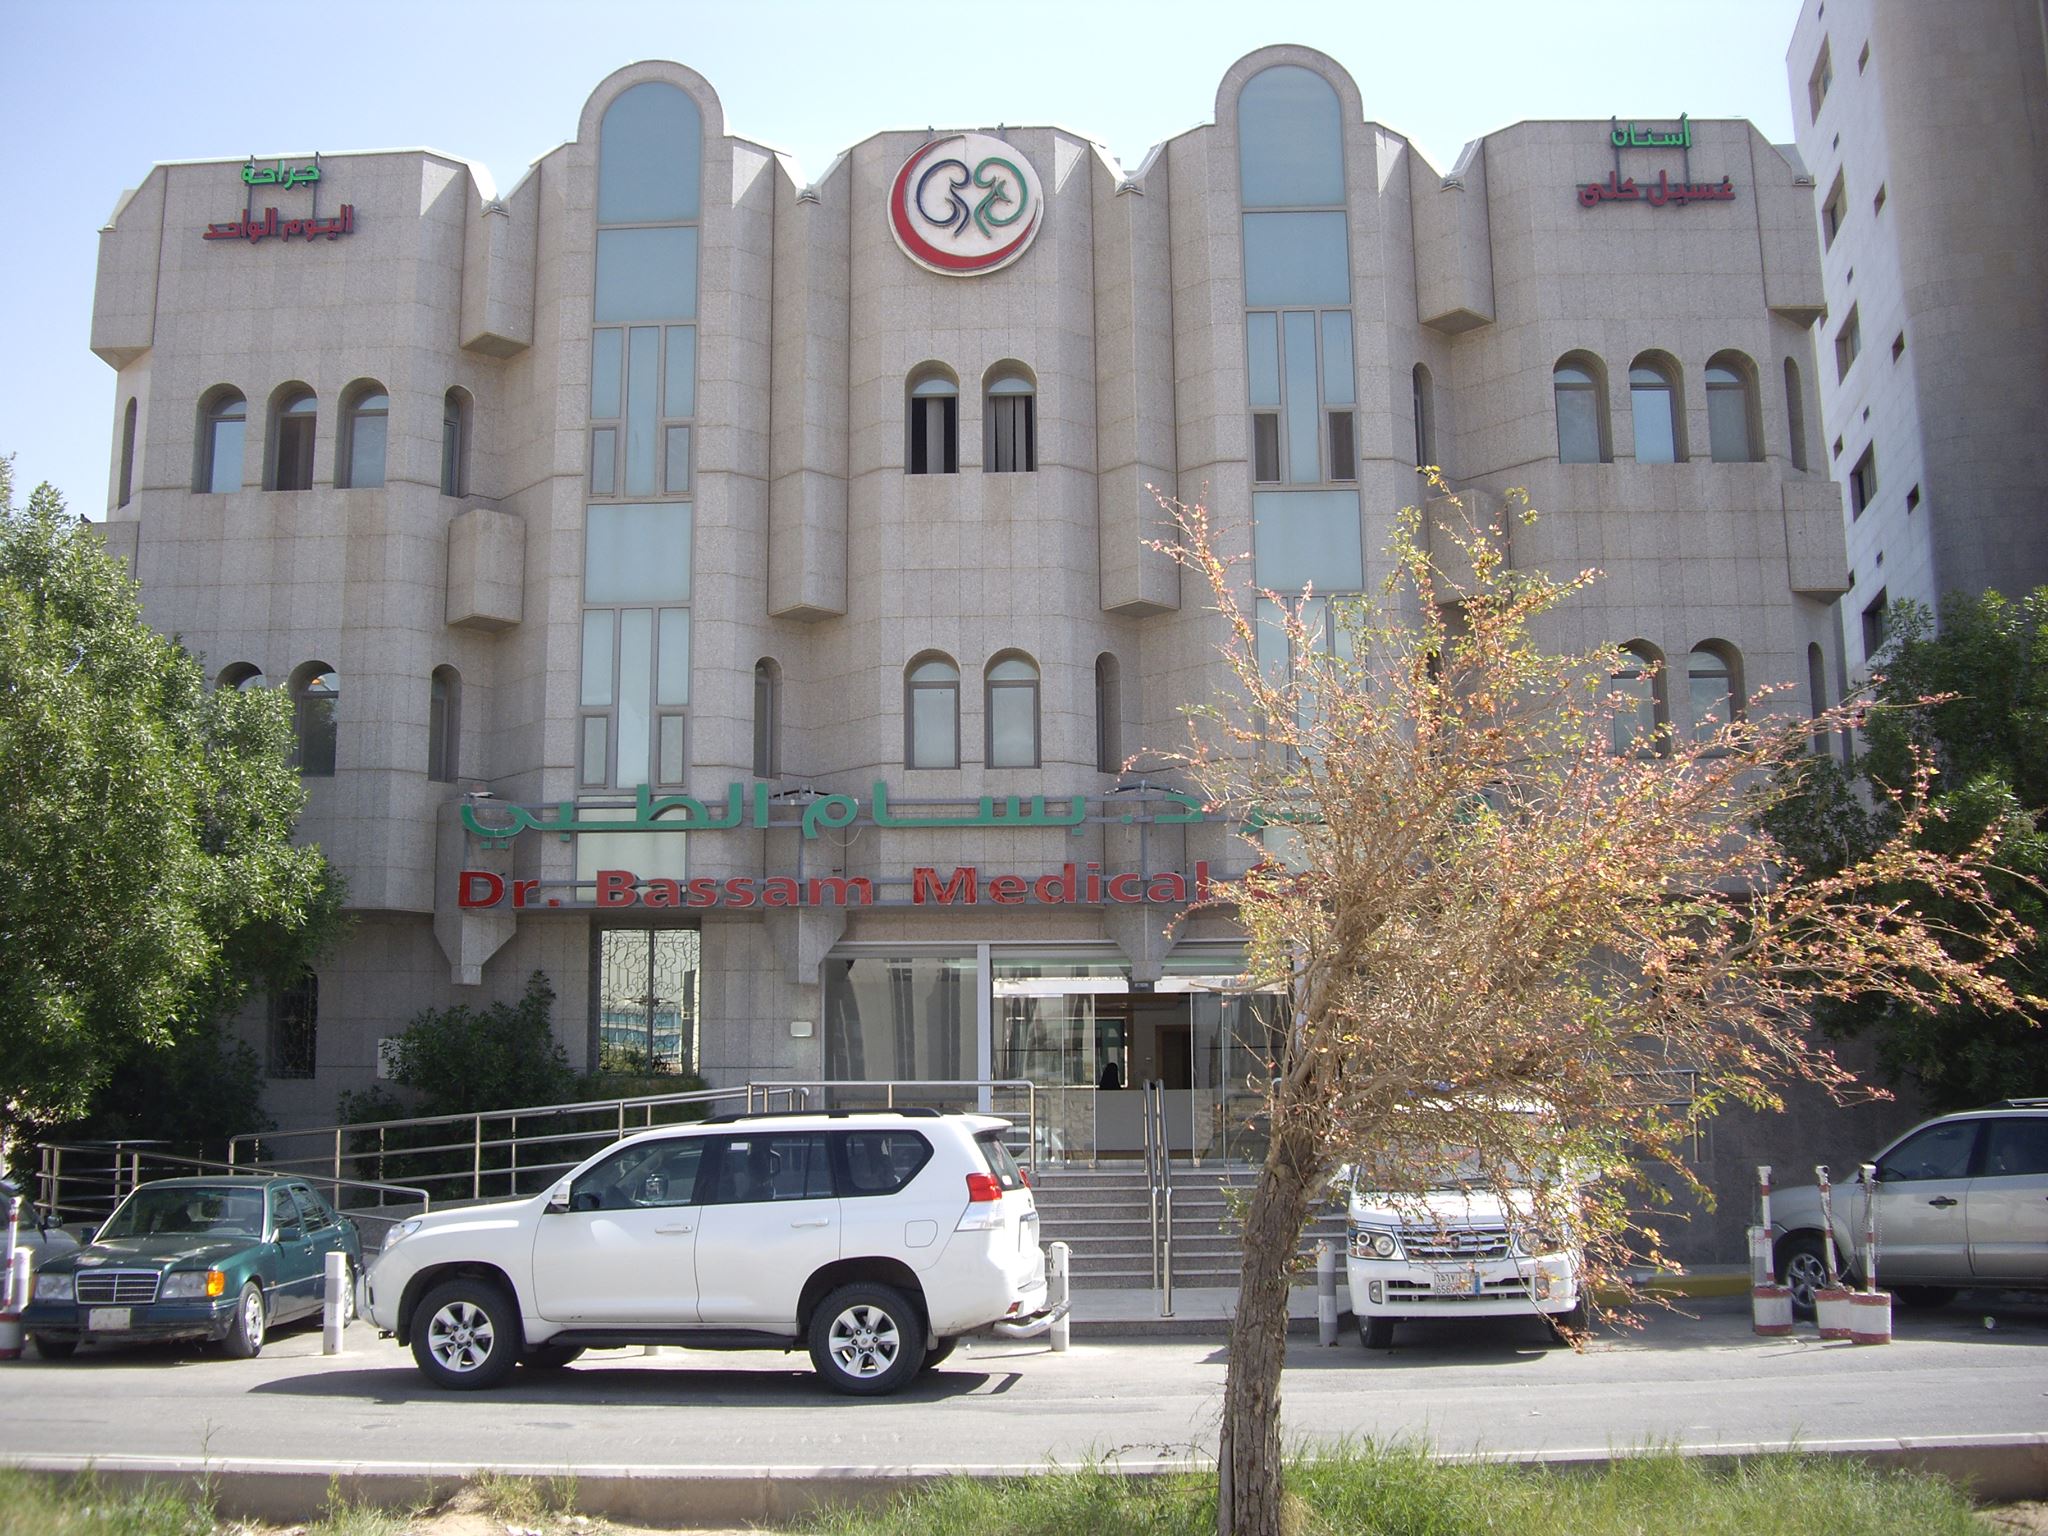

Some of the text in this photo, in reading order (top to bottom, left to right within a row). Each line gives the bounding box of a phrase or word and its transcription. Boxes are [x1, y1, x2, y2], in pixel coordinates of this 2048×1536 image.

[1611, 112, 1691, 147] أسنان
[241, 159, 321, 191] جراحة
[1647, 169, 1736, 207] غسيل
[202, 204, 352, 244] اليوم الواحد
[460, 783, 769, 849] الطبي
[802, 779, 1085, 839] بسام
[457, 869, 560, 908] Dr.
[596, 870, 874, 907] Bassam
[912, 860, 1210, 905] Medical
